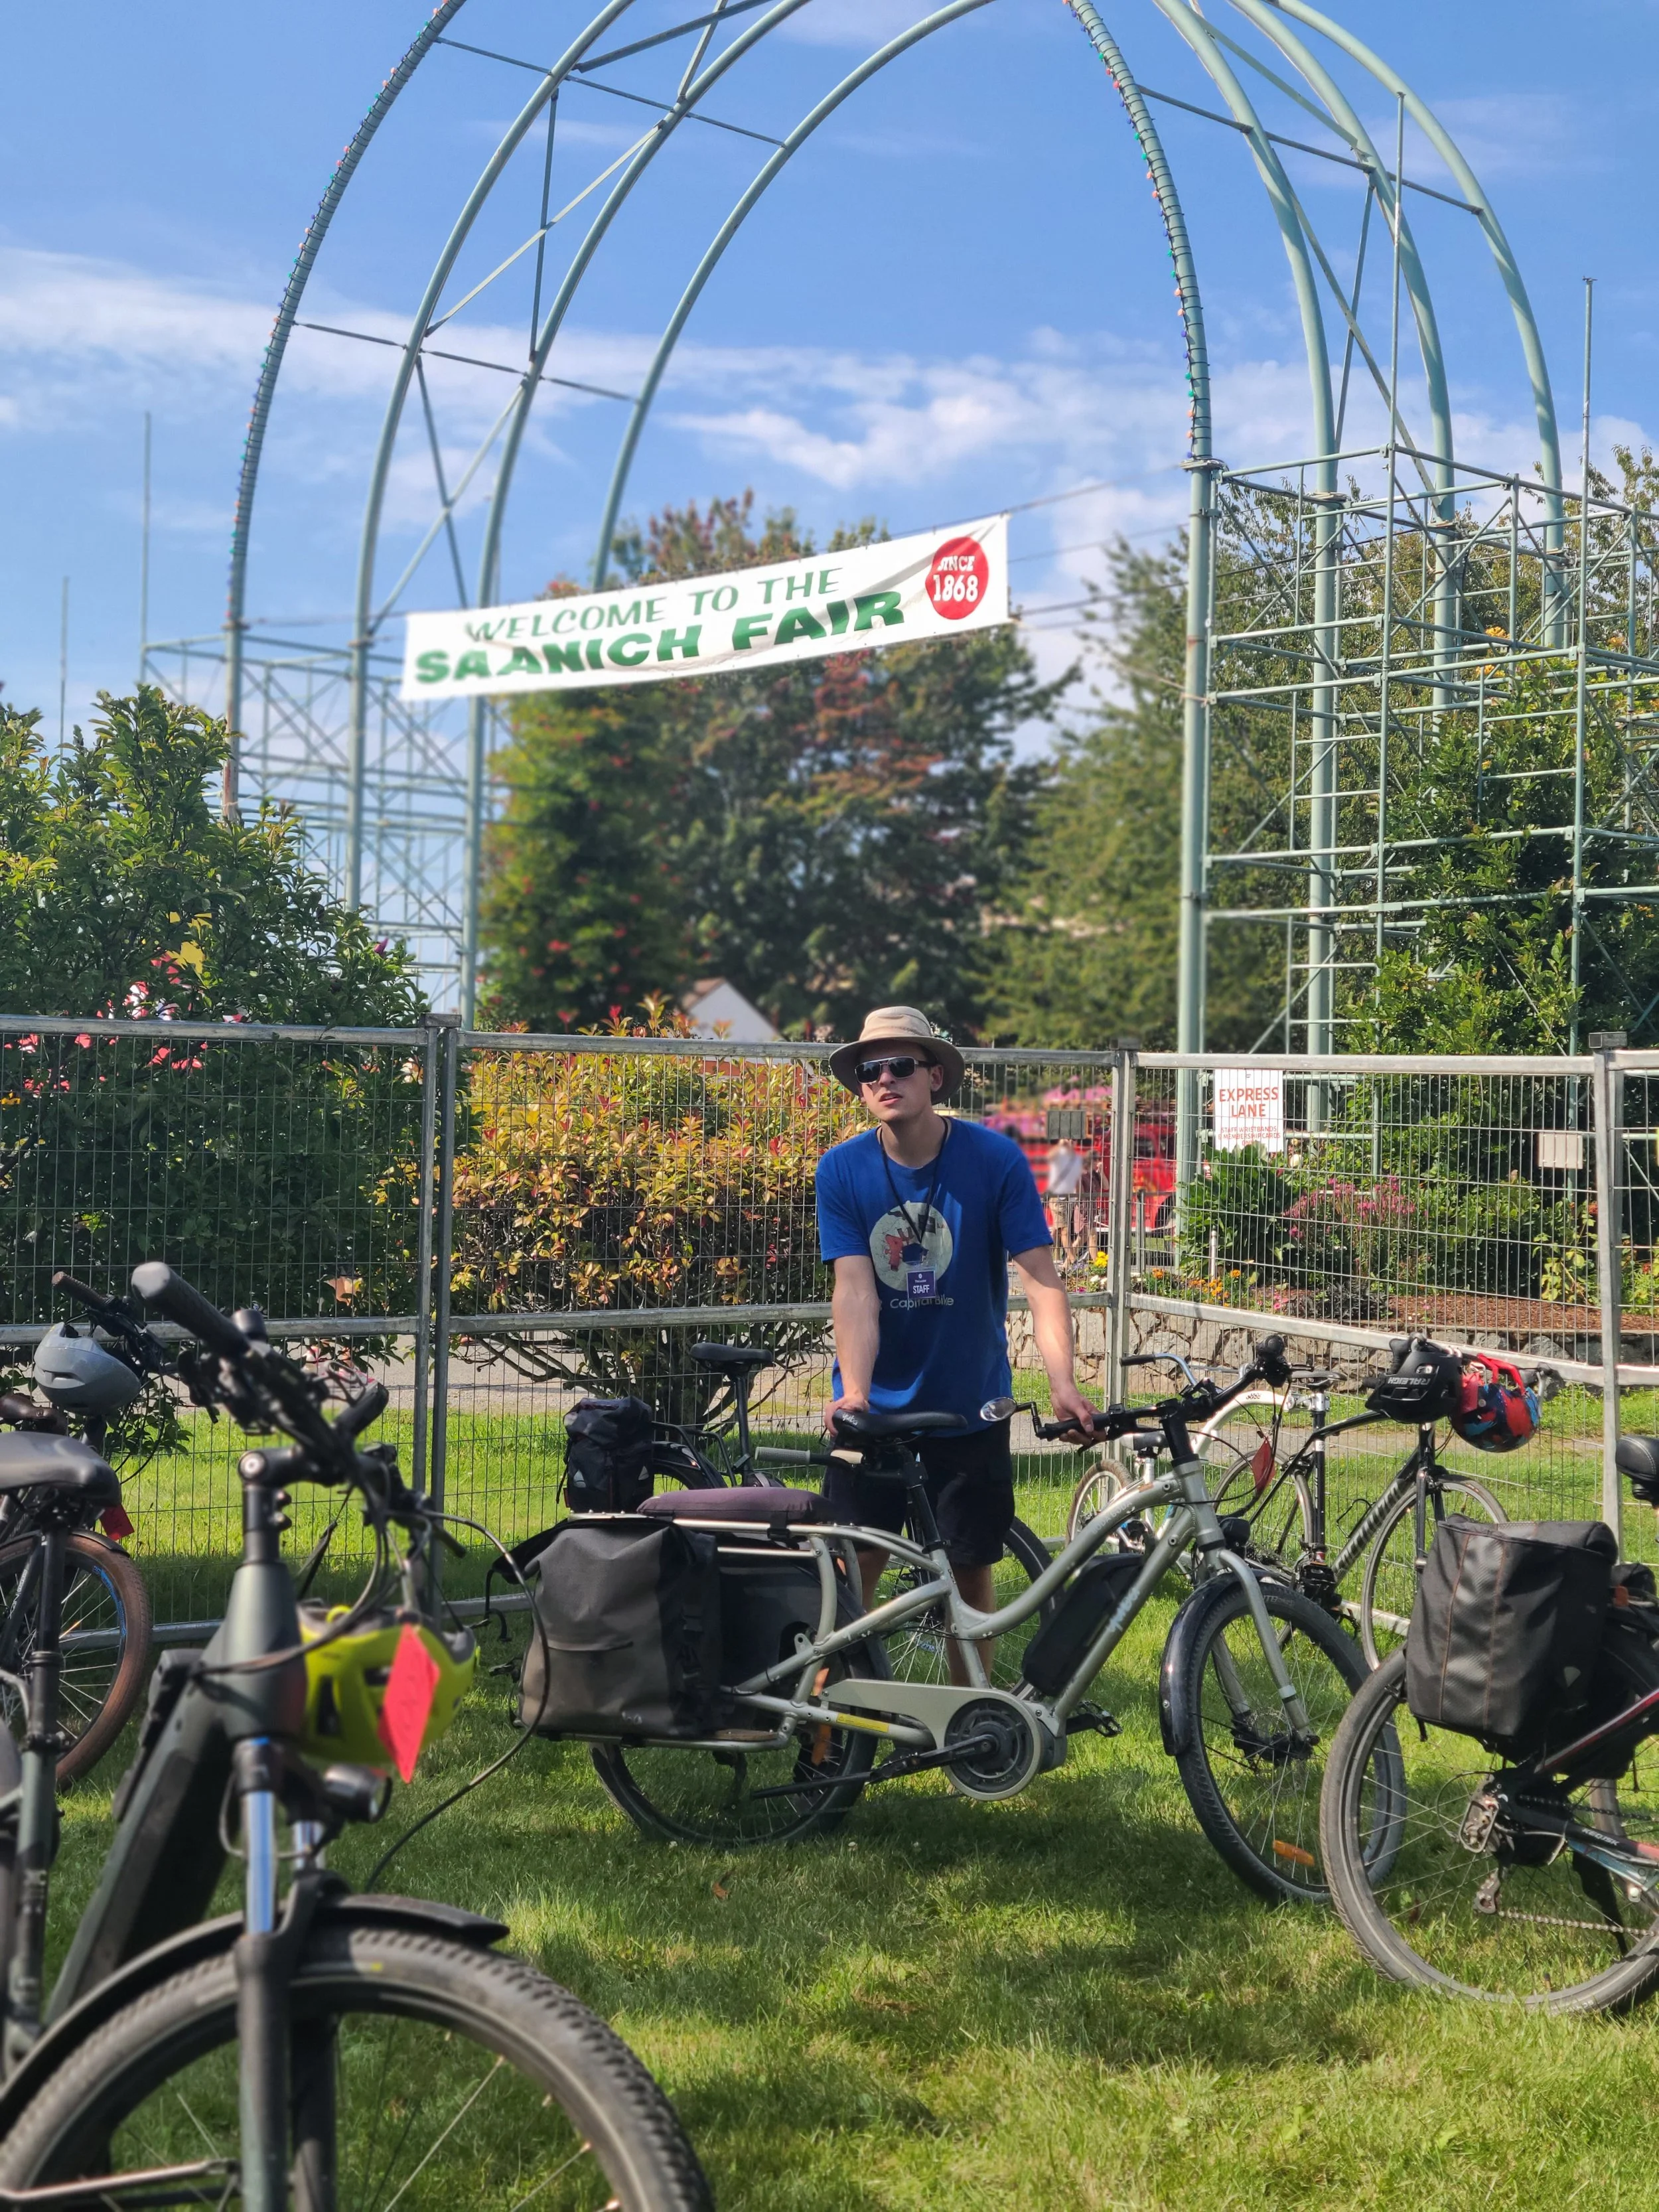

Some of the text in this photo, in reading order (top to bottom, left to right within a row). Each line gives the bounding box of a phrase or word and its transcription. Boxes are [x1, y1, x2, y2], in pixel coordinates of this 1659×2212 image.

[933, 574, 978, 603] 1868
[466, 567, 843, 642] WELCOME TO THE
[416, 591, 904, 684] SAANICH FAIR
[1219, 1087, 1279, 1102] EXPRESS
[1232, 1104, 1266, 1118] LANE
[912, 1284, 930, 1294] STAFF
[1388, 1376, 1431, 1386] RALEIGH
